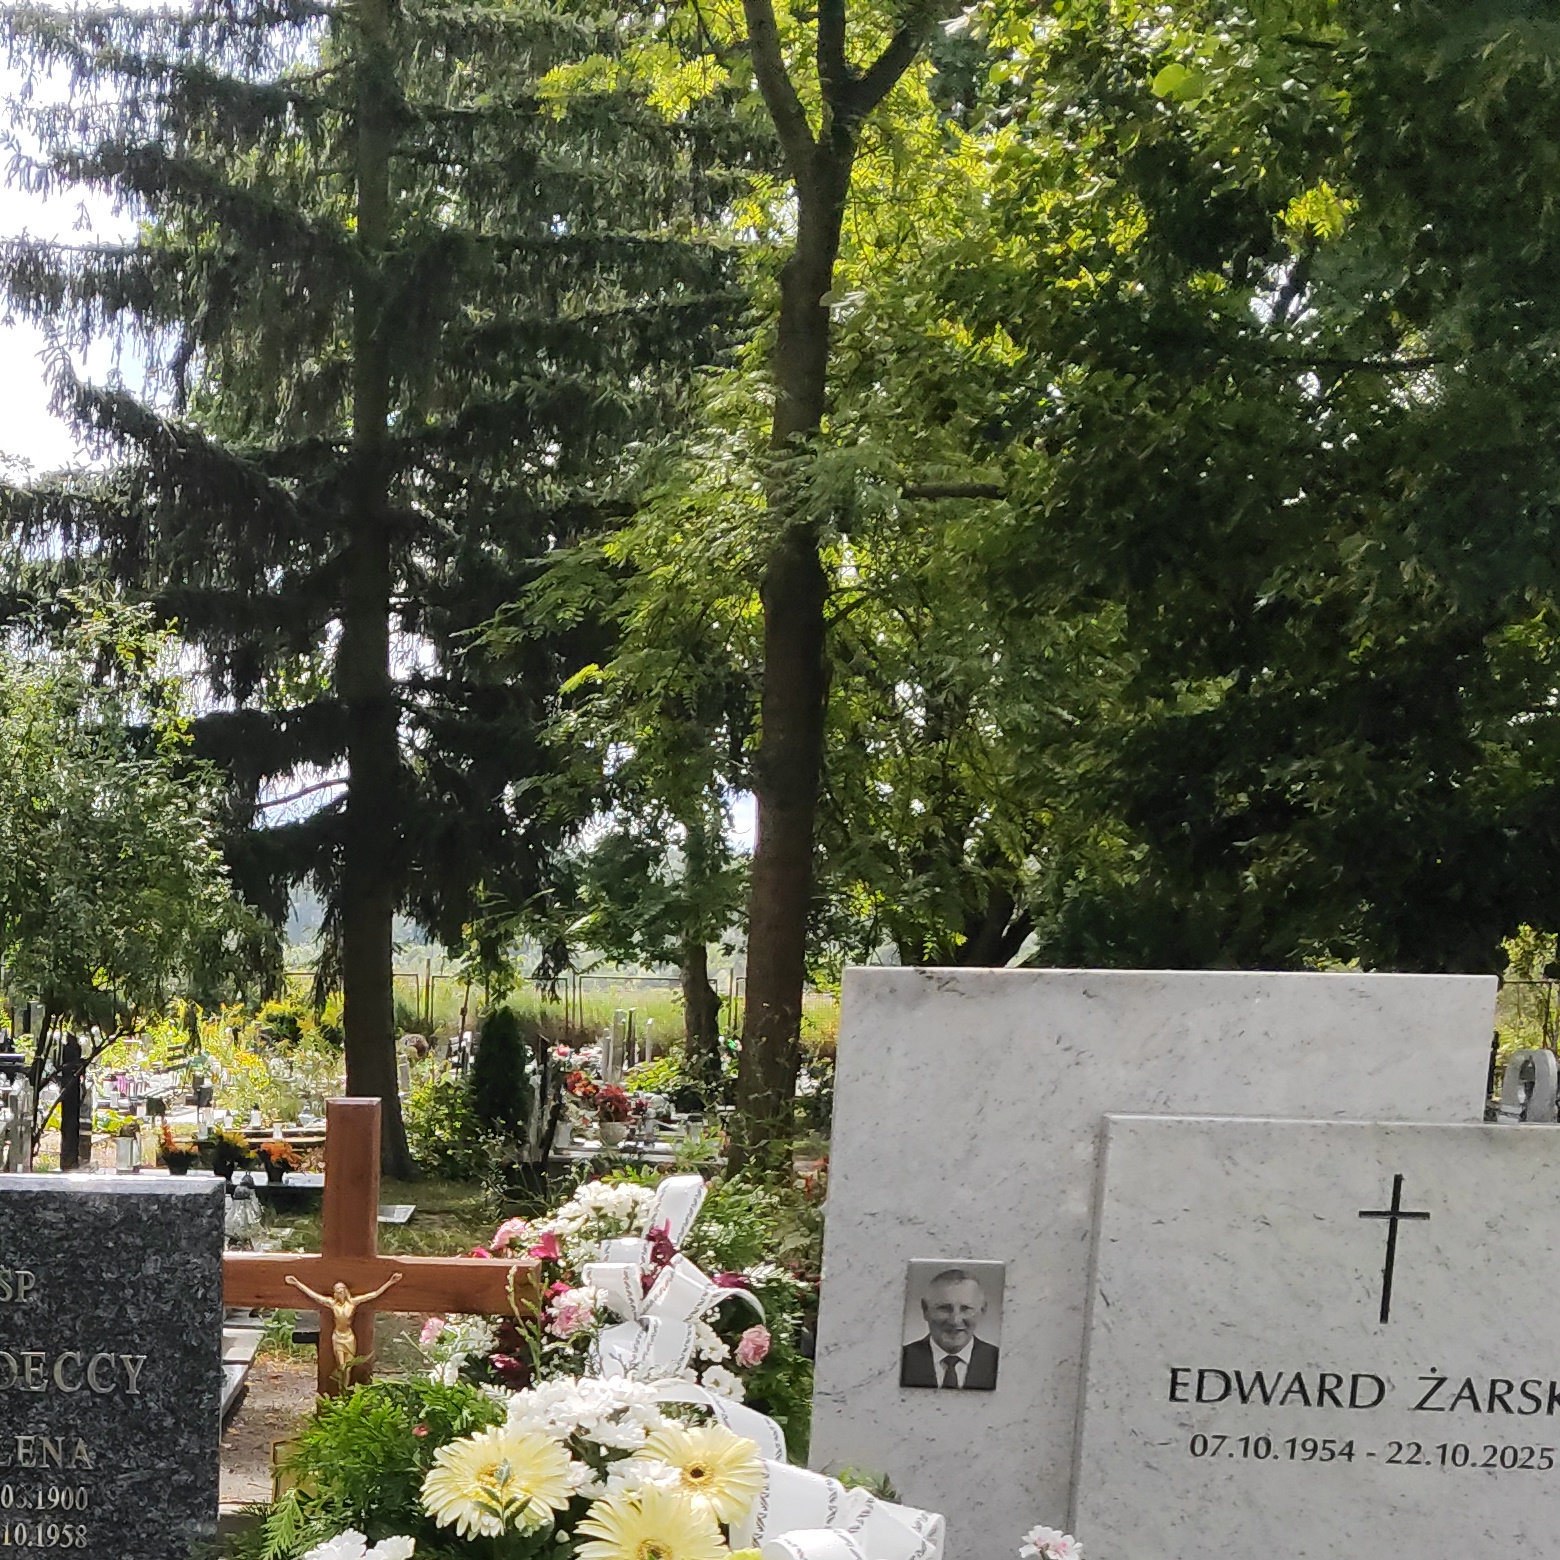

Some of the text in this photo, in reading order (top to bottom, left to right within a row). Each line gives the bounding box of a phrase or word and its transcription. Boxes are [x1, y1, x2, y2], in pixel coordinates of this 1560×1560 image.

[1168, 1366, 1560, 1416] EDWARD ŻARSK
[1190, 1434, 1355, 1462] 07.10.1954
[1385, 1441, 1555, 1471] 22.10.2025
